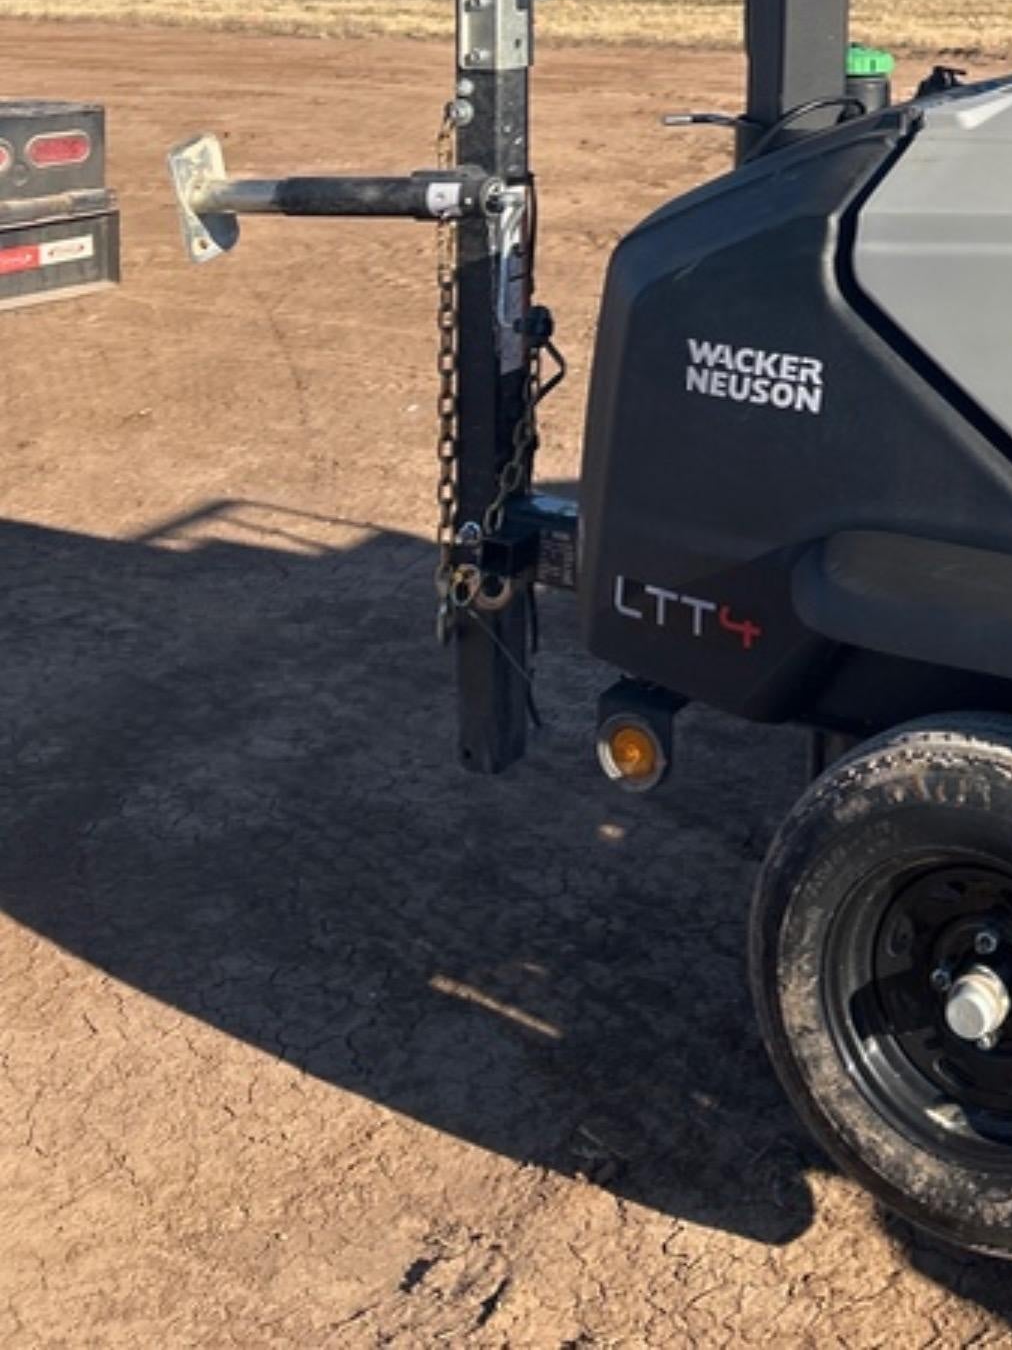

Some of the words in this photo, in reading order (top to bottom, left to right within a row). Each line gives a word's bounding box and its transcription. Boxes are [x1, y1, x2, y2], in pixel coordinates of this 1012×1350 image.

[686, 337, 824, 385] WACKER
[685, 364, 823, 415] NEUSON
[613, 574, 763, 650] LTT4
